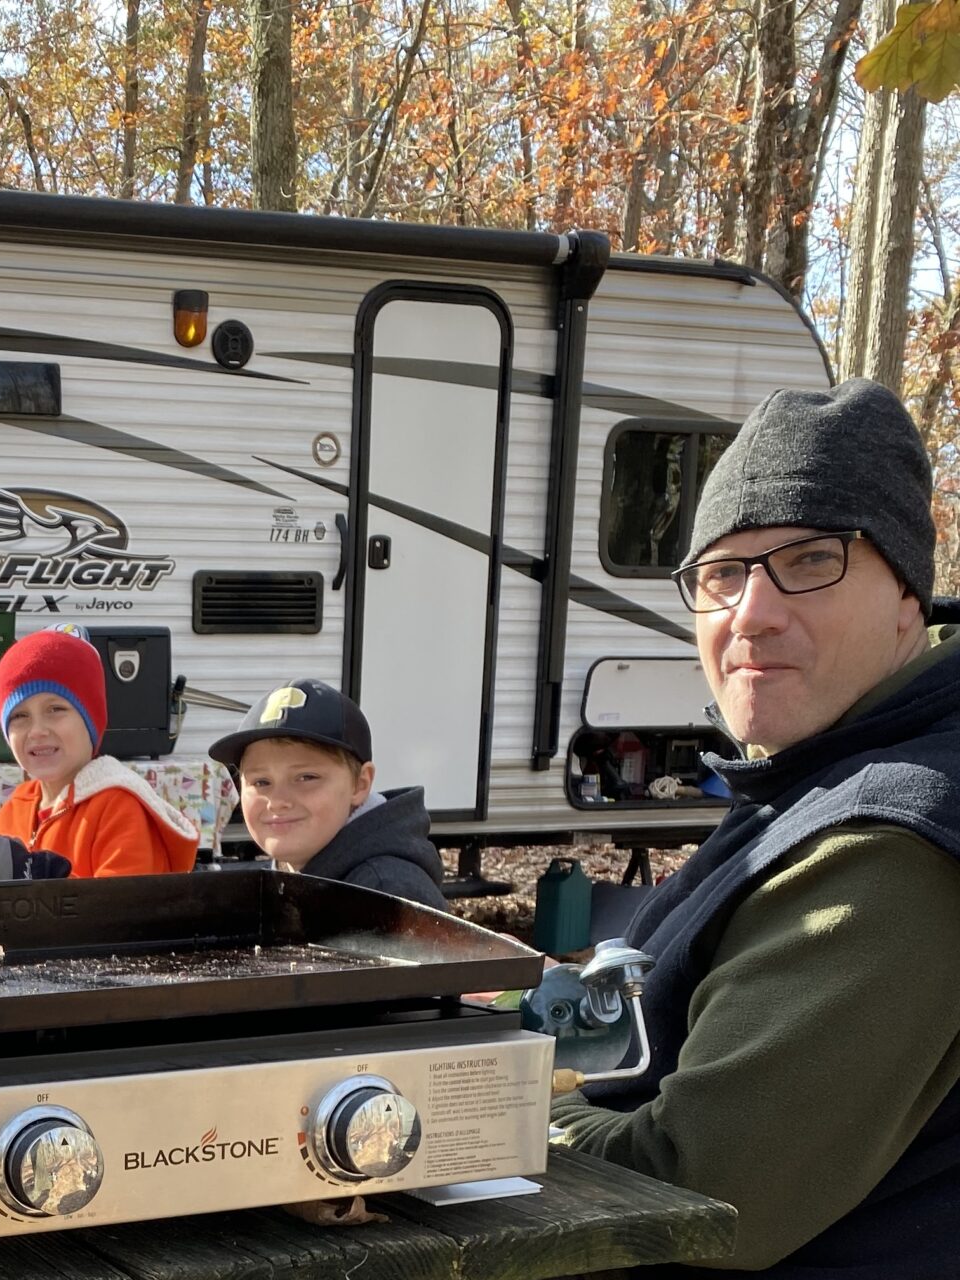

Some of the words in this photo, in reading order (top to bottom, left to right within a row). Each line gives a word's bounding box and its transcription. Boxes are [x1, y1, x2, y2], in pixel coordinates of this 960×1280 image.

[270, 528, 290, 543] 174
[294, 528, 310, 543] BH
[86, 597, 134, 612] Jayco
[260, 686, 307, 723] P
[356, 1064, 369, 1073] OFF
[429, 1061, 456, 1072] LIGHTING
[456, 1058, 498, 1070] INSTRUCTIONS
[36, 1093, 50, 1103] OFF
[124, 1137, 280, 1171] BLACKSTONE
